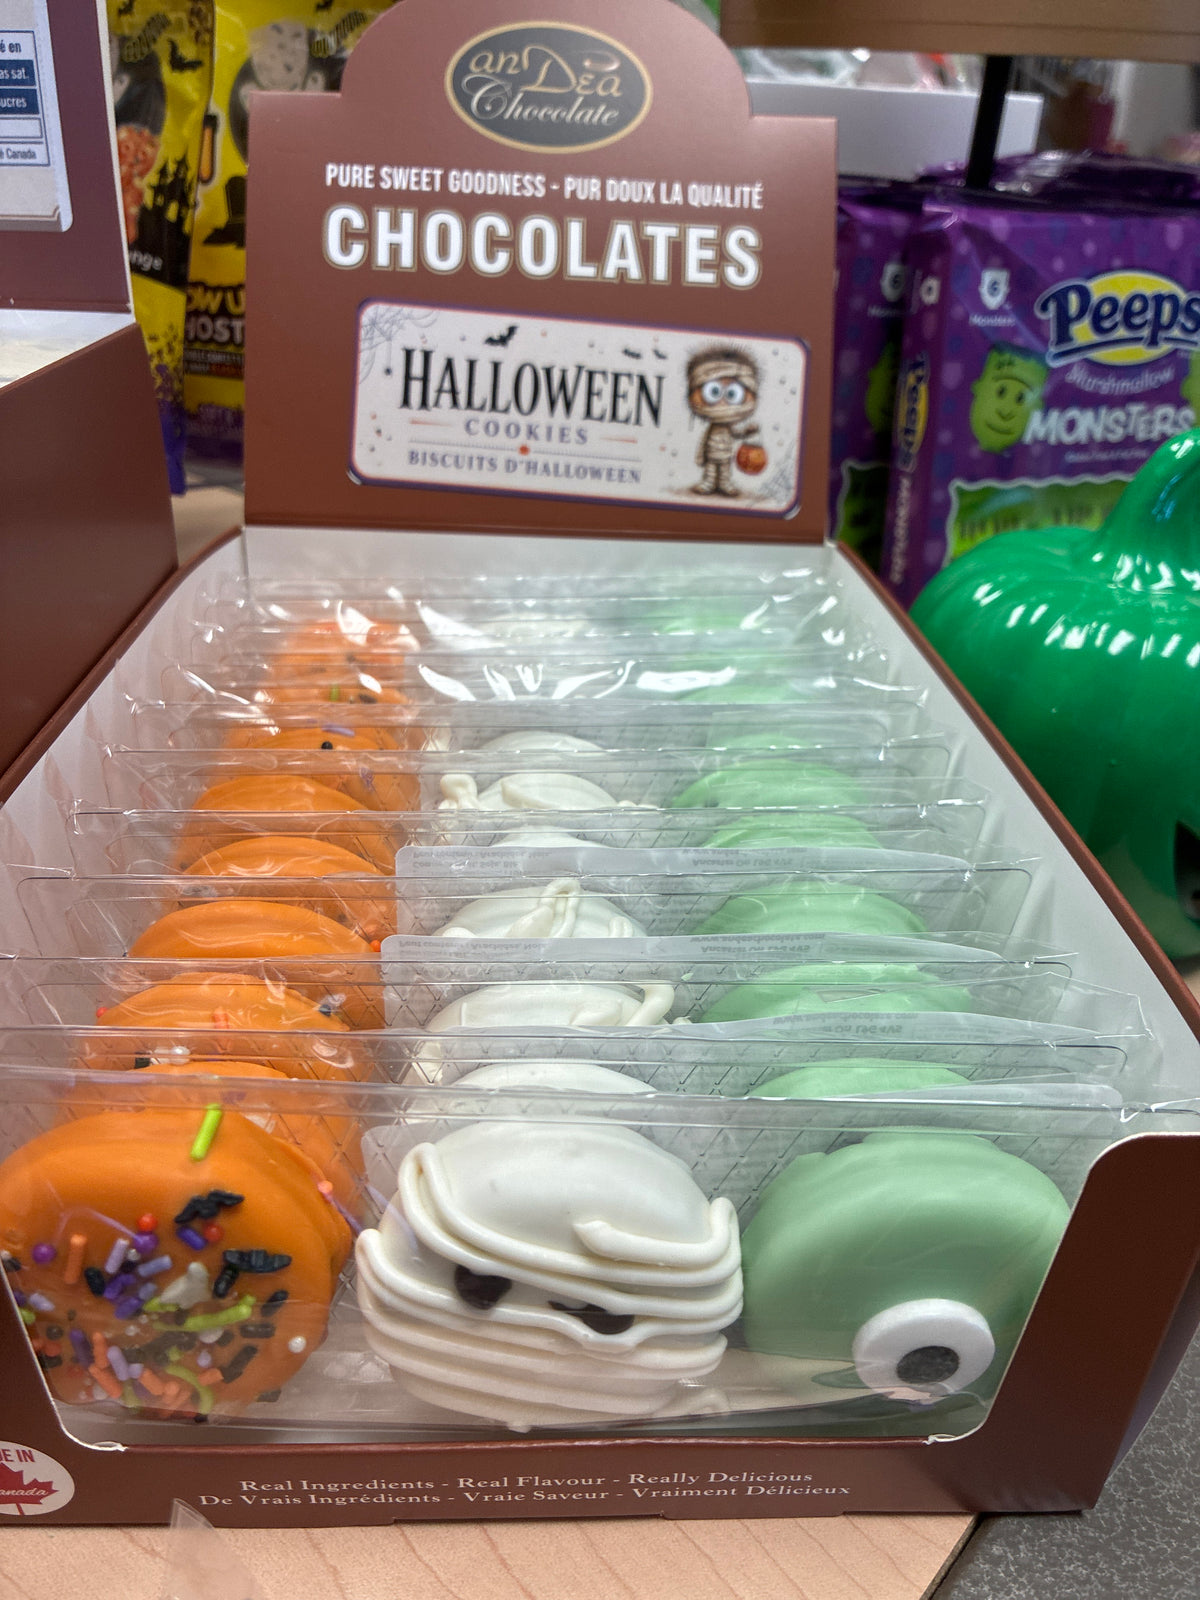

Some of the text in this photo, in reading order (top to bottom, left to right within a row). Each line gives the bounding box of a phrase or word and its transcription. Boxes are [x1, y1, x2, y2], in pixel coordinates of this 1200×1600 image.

[8, 42, 22, 53] en
[0, 97, 27, 108] ucres
[461, 74, 619, 127] Chocolate
[6, 148, 37, 160] Canada
[326, 163, 375, 188] PURE
[380, 166, 442, 192] SWEET
[448, 169, 546, 198] GOODNESS
[564, 176, 601, 200] PUR
[606, 178, 656, 204] DOUX
[659, 182, 683, 206] LA
[687, 180, 763, 209] QUALITÉ
[323, 204, 763, 290] CHOCOLATES
[1036, 281, 1200, 352] Peeps
[400, 347, 666, 427] HALLOWEEN
[464, 418, 589, 445] COOKIES
[408, 449, 642, 485] BISCUITS D'HALLOWEEN
[15, 1449, 36, 1463] IN
[0, 1487, 49, 1496] anada
[241, 1480, 293, 1491] Real
[301, 1479, 435, 1494] Ingredients
[457, 1477, 508, 1488] Real
[516, 1475, 606, 1488] Flavour
[628, 1472, 700, 1485] Really
[708, 1471, 813, 1483] Delicious
[200, 1494, 233, 1506] De
[241, 1493, 302, 1505] Vrais
[310, 1490, 441, 1506] Ingrédients
[464, 1491, 525, 1502] Vraie
[533, 1489, 609, 1501] Saveur
[633, 1487, 738, 1499] Vraiment
[746, 1485, 851, 1497] Délicieux
